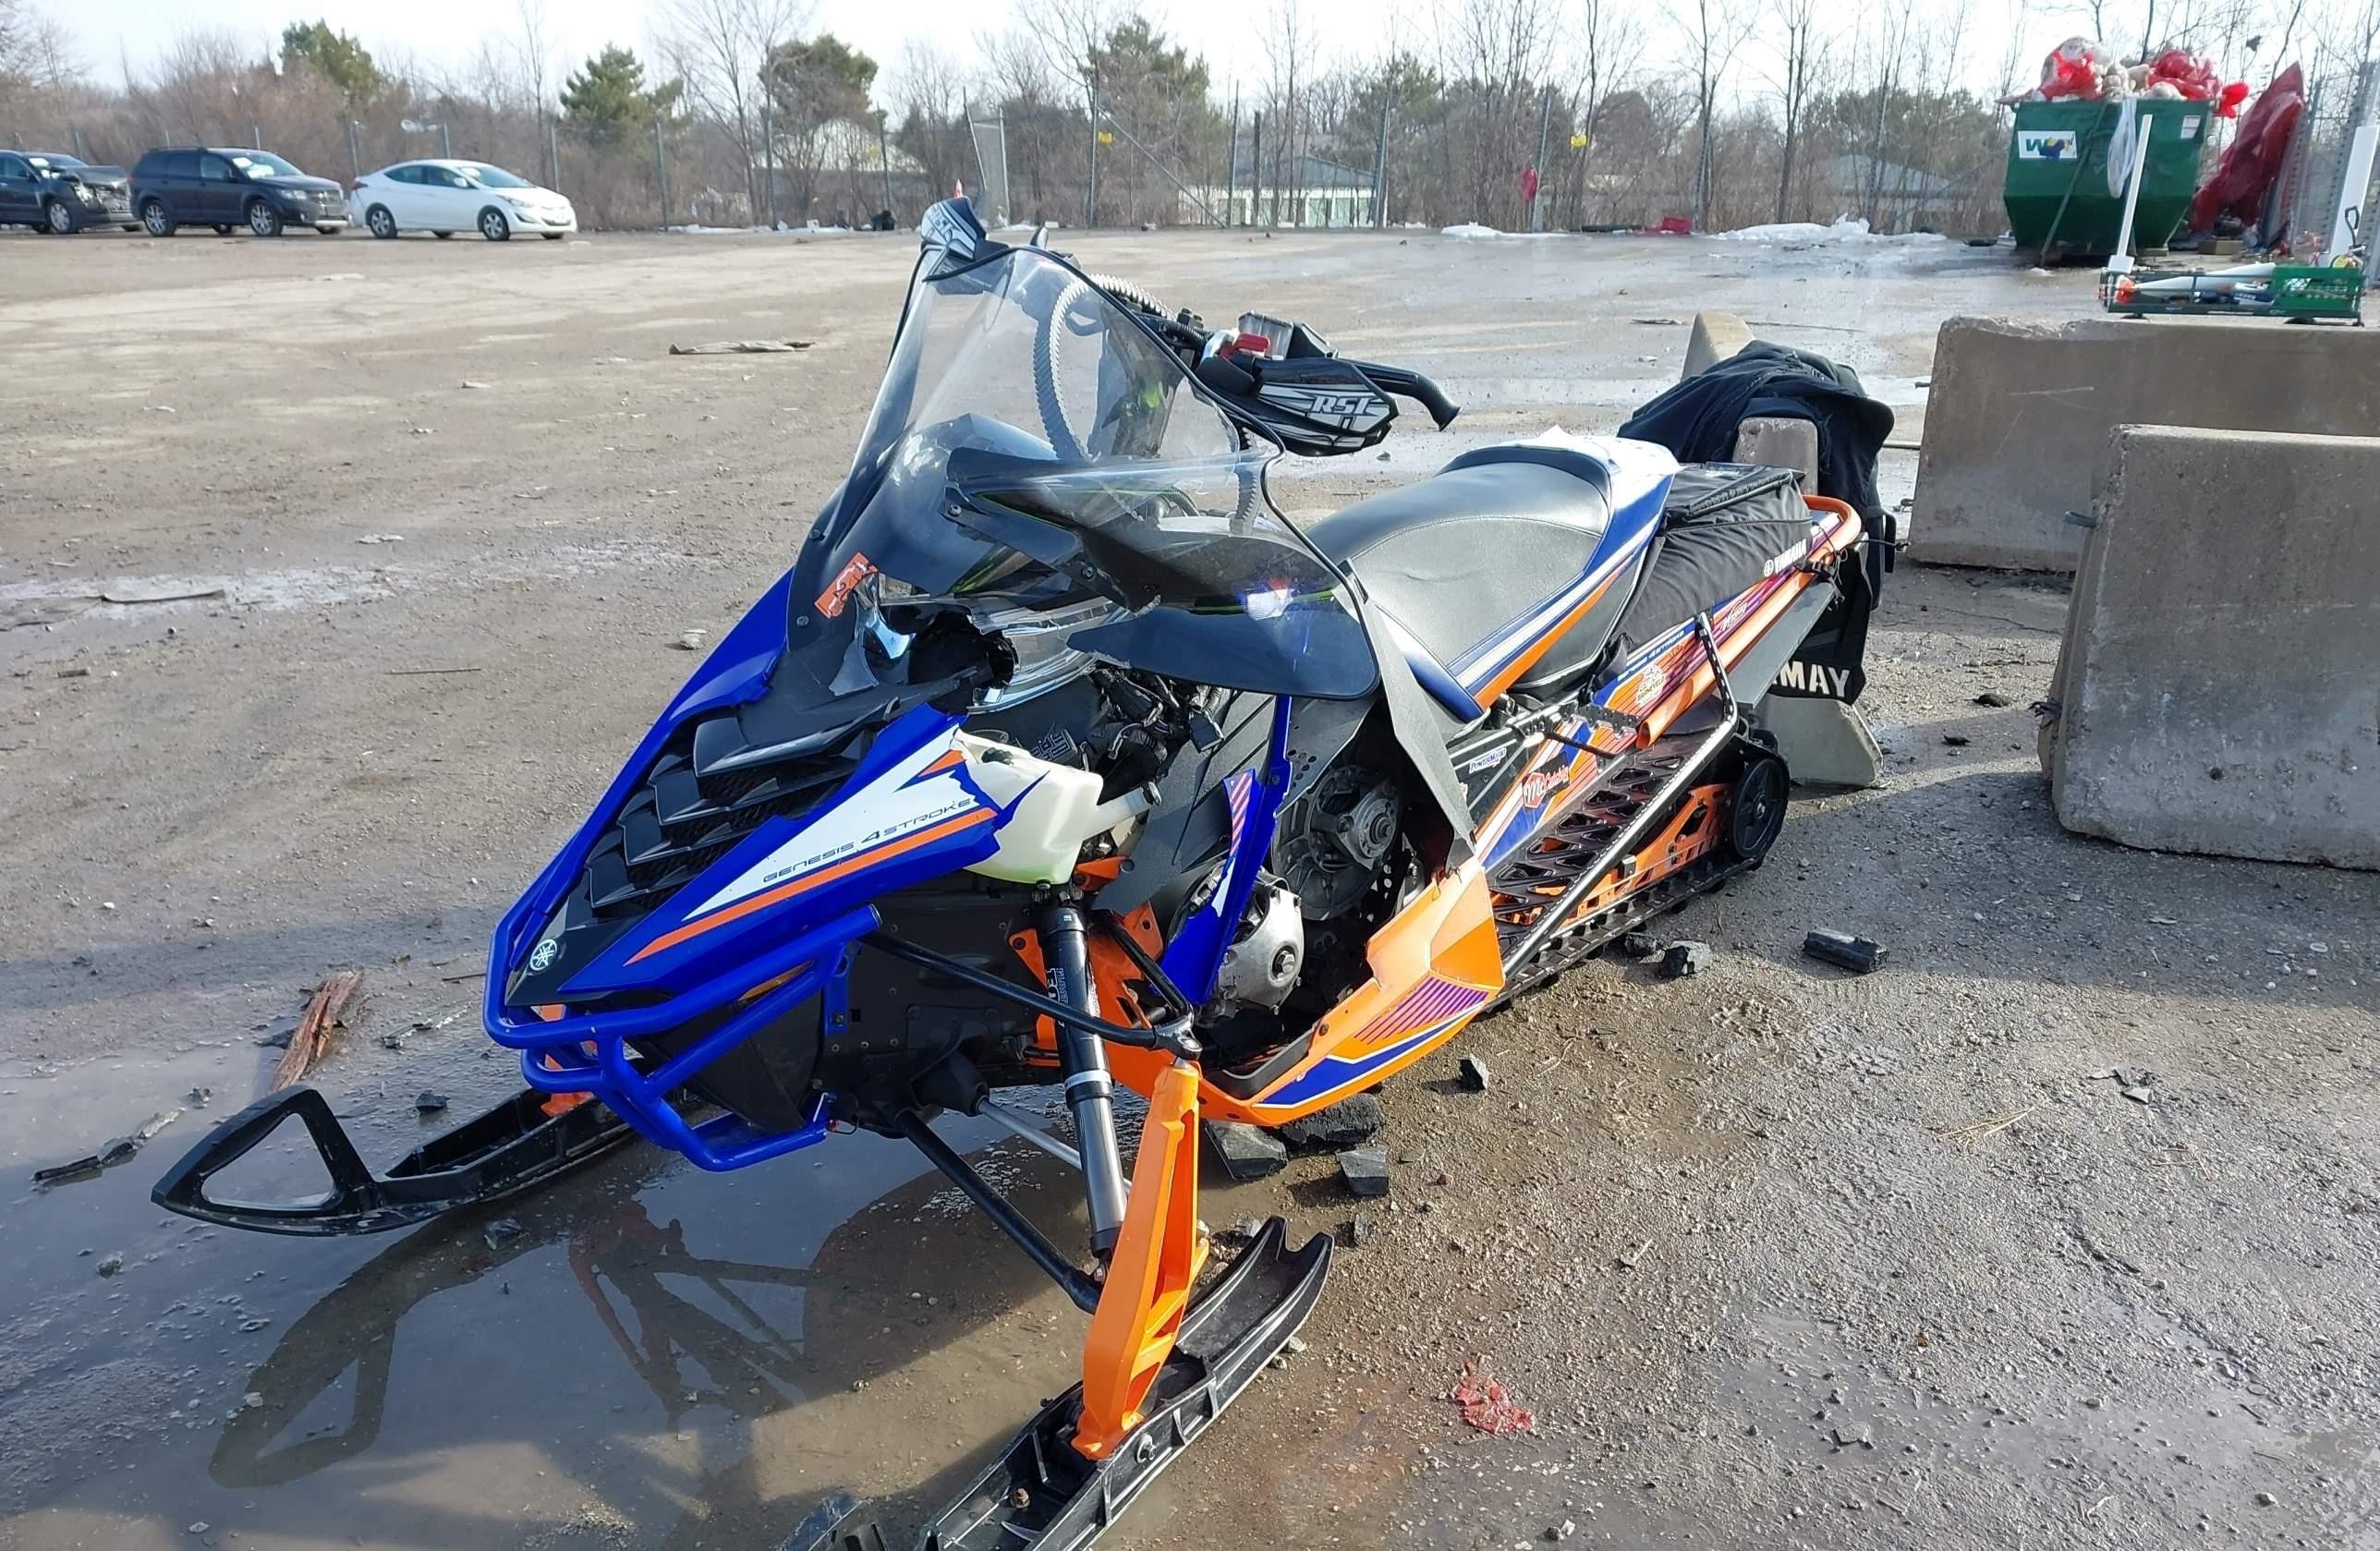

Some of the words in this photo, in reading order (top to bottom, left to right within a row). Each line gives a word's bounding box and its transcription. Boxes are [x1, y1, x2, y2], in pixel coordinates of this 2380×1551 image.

[1311, 395, 1370, 415] RSI
[1773, 660, 1851, 697] MAY
[762, 842, 855, 883] GENESIS
